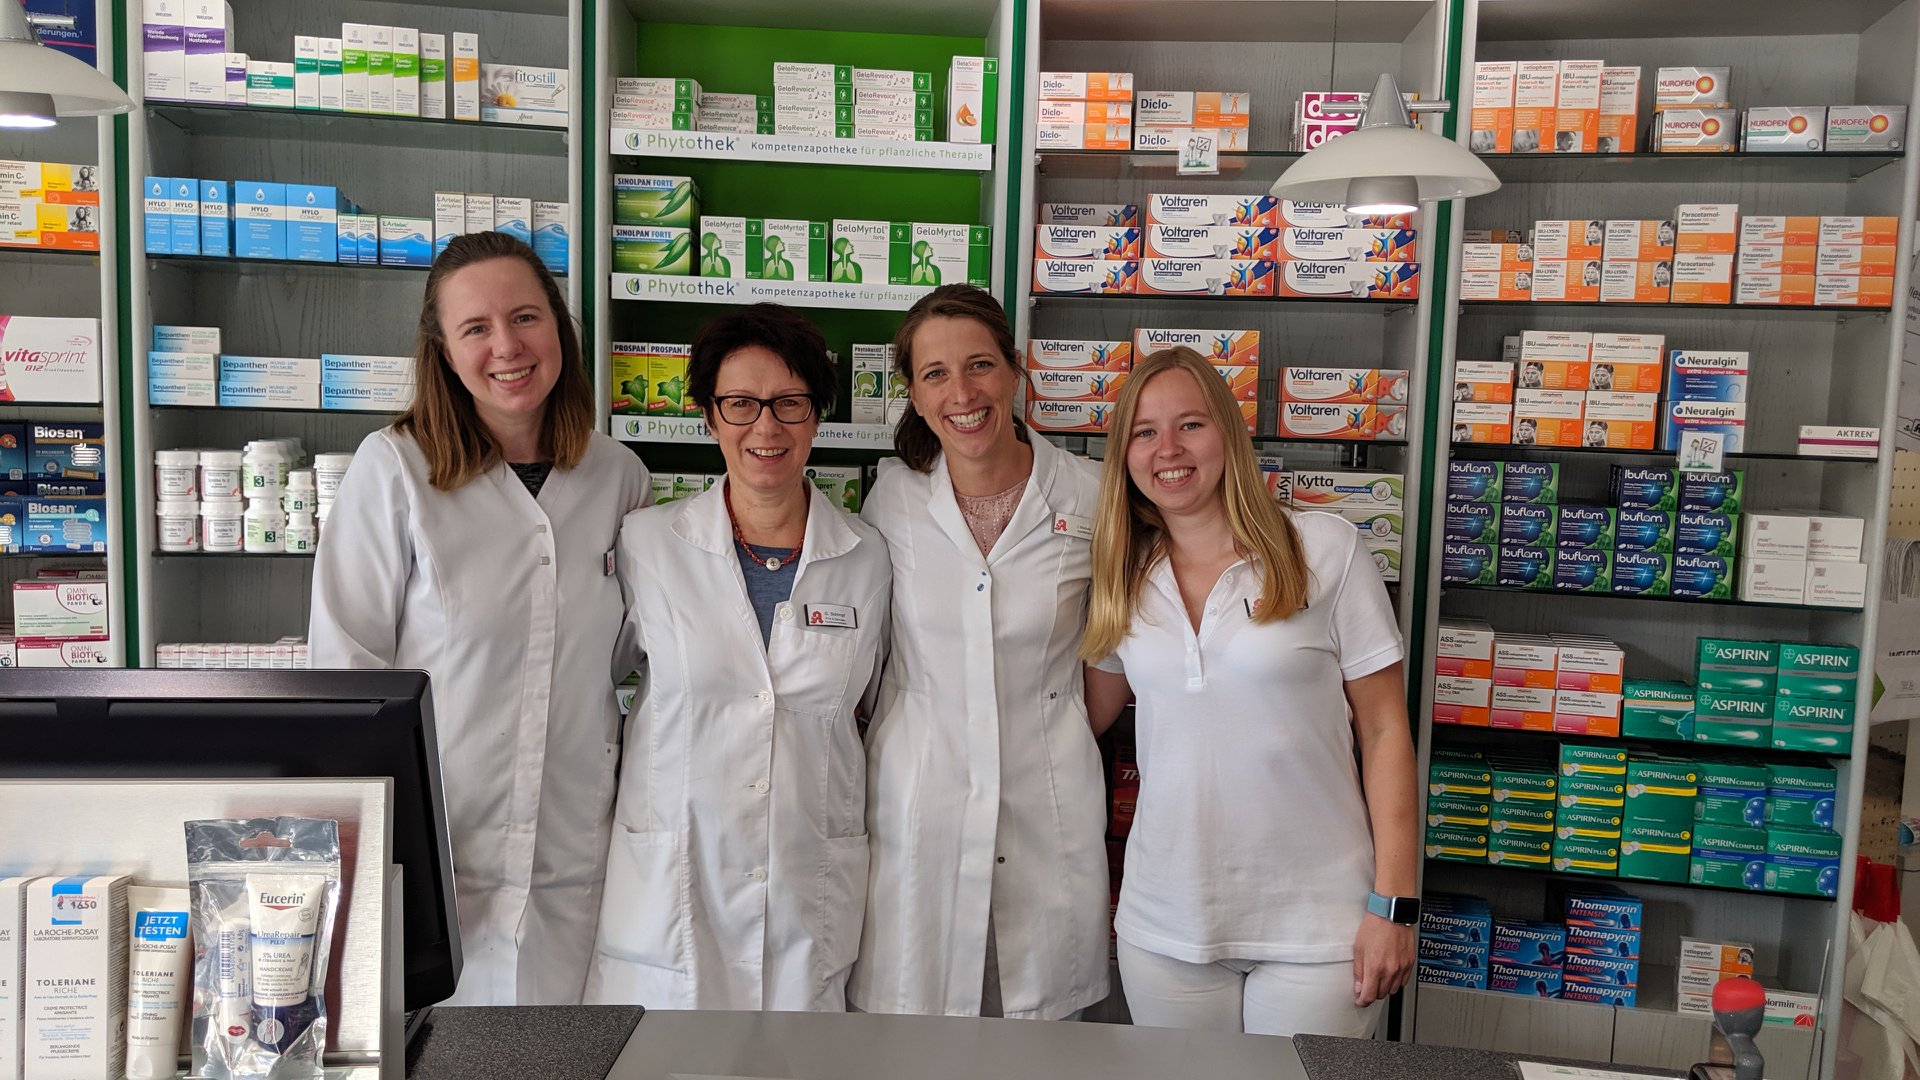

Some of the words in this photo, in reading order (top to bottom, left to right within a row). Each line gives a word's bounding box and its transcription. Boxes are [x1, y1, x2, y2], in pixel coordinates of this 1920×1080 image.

[514, 70, 556, 84] fitostill
[1043, 80, 1065, 88] Diclo-
[1140, 99, 1172, 110] Diclo-
[1139, 134, 1170, 145] Diclo-
[648, 134, 735, 154] Phytothek
[752, 141, 858, 155] Kompetenzapotheke
[861, 146, 875, 155] für
[879, 147, 936, 158] pflanzliche
[939, 150, 983, 160] Therapie
[618, 177, 650, 186] SINOLPAN
[653, 179, 673, 187] FORTE
[1159, 195, 1208, 207] Voltaren
[1050, 205, 1095, 216] Voltaren
[704, 220, 742, 230] GeloMyrtol
[768, 223, 806, 233] GeloMyrtol
[837, 224, 885, 235] GeloMyrtol
[616, 229, 650, 238] SINOLPAN
[652, 230, 672, 238] FORTE
[916, 227, 964, 238] GeloMyrtol
[1049, 226, 1096, 238] Voltaren
[1159, 226, 1208, 238] Voltaren
[1293, 229, 1343, 240] Voltaren
[1046, 260, 1094, 272] Voltaren
[1151, 259, 1201, 271] Voltaren
[1294, 262, 1345, 274] Voltaren
[648, 279, 735, 296] Phytothek
[752, 286, 856, 299] Kompetenzapotheke
[859, 290, 874, 299] für
[878, 291, 925, 301] pflanzlic
[157, 331, 190, 339] Bepanthen
[1147, 330, 1200, 342] Voltaren
[614, 345, 646, 353] PROSPAN
[1040, 341, 1084, 352] Voltaren
[5, 348, 88, 366] vitasprint
[1687, 356, 1737, 367] Neuralgin
[223, 360, 268, 370] Bepanthen
[324, 358, 372, 368] Bepanthen
[1040, 372, 1082, 382] Voltaren
[1290, 369, 1342, 381] Voltaren
[221, 385, 267, 394] Bepanthen
[324, 386, 372, 396] Bepanthen
[1038, 402, 1081, 412] Voltaren
[1288, 404, 1340, 416] Voltaren
[1685, 406, 1735, 417] Neuralgin
[34, 426, 83, 440] Biosan
[648, 420, 710, 438] Phytoth
[1450, 463, 1491, 474] Ibuflam
[1505, 464, 1546, 474] Ibuflam
[1625, 470, 1667, 480] Ibuflam
[1686, 473, 1730, 483] Ibuflam
[255, 477, 264, 486] 3
[1297, 474, 1334, 489] Kytta
[1447, 504, 1488, 514] Ibuflam
[1504, 506, 1545, 517] Ibuflam
[1562, 509, 1603, 520] Ibuflam
[1621, 512, 1663, 522] Ibuflam
[1680, 514, 1724, 526] Ibuflam
[1445, 544, 1485, 555] Ibuflam
[1502, 548, 1542, 558] Ibuflam
[1559, 551, 1600, 562] Ibuflam
[1617, 554, 1659, 564] Ibuflam
[1676, 557, 1720, 568] Ibuflam
[66, 587, 88, 596] OMNI
[1715, 648, 1769, 662] ASPIRIN
[1794, 654, 1849, 667] ASPIRIN
[1634, 689, 1671, 699] ASPIRIN
[1710, 700, 1765, 713] ASPIRIN
[1788, 706, 1844, 719] ASPIRIN
[1572, 750, 1602, 759] ASPIRIN
[1439, 771, 1467, 779] ASPIRIN
[1637, 770, 1669, 779] ASPIRIN
[1702, 775, 1734, 785] ASPIRIN
[260, 892, 304, 905] Eucerin
[1570, 898, 1638, 914] Thomapyrin
[1570, 909, 1606, 918] INTENSIV
[144, 916, 178, 925] JETZT
[1422, 912, 1487, 928] Thomapyrin
[138, 927, 182, 935] TESTEN
[1422, 922, 1452, 932] CLASSIC
[257, 930, 301, 940] UreaRepair
[1495, 926, 1562, 942] Thomapyrin
[1569, 926, 1636, 942] Thomapyrin
[1494, 941, 1520, 950] DUO
[1568, 936, 1604, 945] INTENSIV
[1420, 939, 1485, 954] Thomapyrin
[1420, 948, 1450, 958] CLASSIC
[1684, 949, 1712, 957] ratiopyrin
[1567, 954, 1634, 970] Thomapyrin
[1419, 965, 1483, 981] Thomapyrin
[1492, 964, 1559, 980] Thomapyrin
[1566, 964, 1603, 973] INTENSIV
[36, 978, 96, 986] TOLERIANE
[1418, 975, 1450, 984] CLASSIC
[1565, 982, 1632, 998] Thomapyrin
[1564, 992, 1600, 1000] INTENSIV
